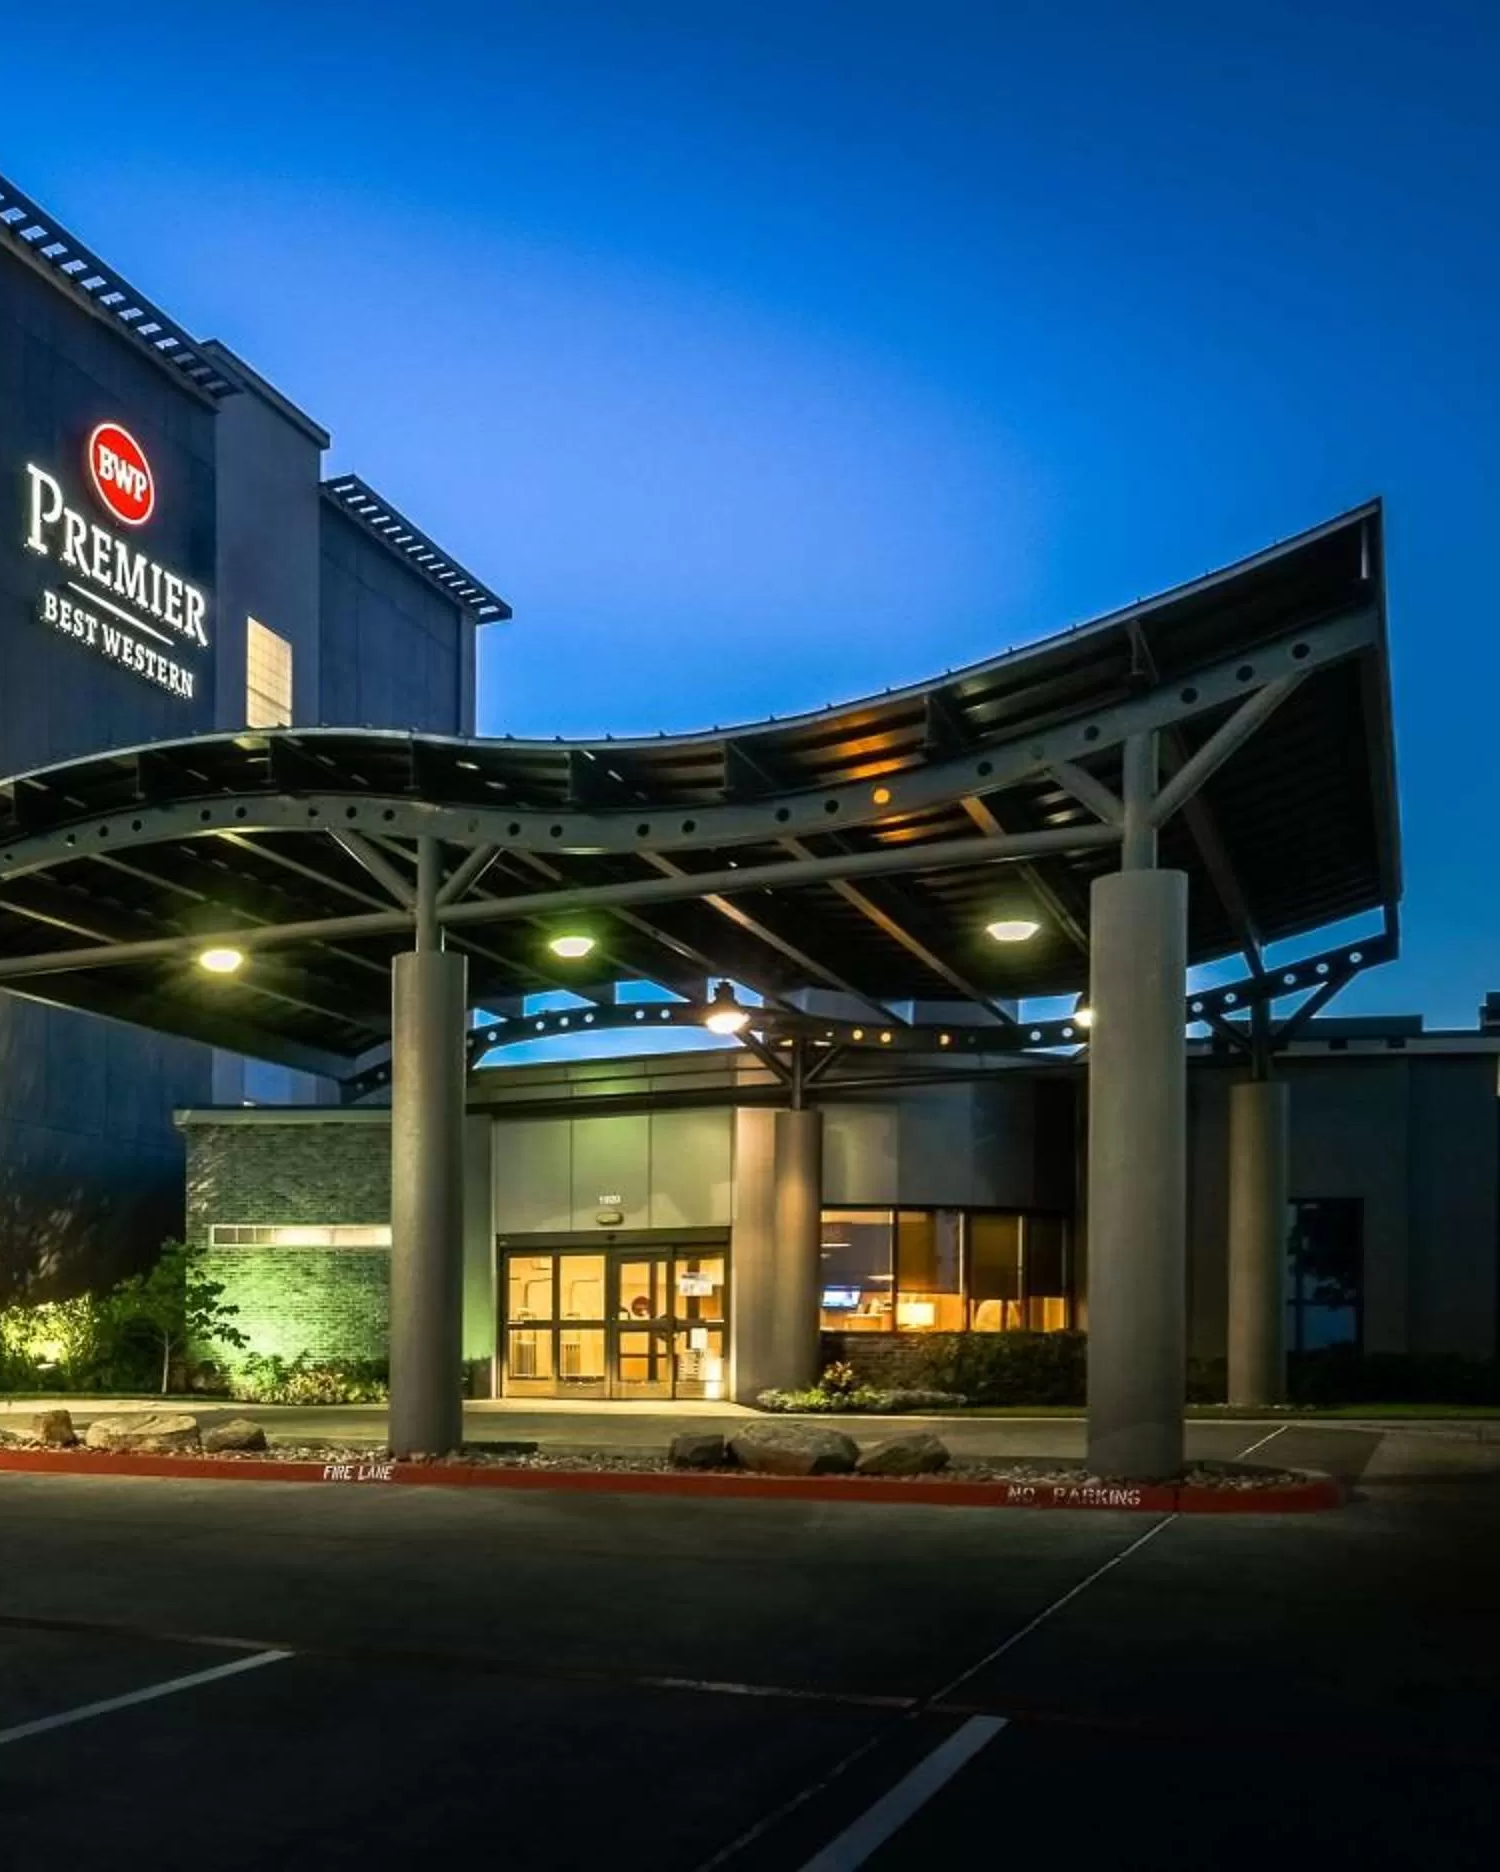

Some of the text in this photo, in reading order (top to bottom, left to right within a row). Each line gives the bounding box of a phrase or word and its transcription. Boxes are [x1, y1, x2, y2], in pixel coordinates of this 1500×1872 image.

[98, 443, 148, 502] BWP
[24, 462, 208, 647] PREMIER
[41, 590, 195, 699] BEST WESTERN
[323, 1465, 395, 1481] FIRE LANE
[1007, 1485, 1142, 1506] NO PARKING
